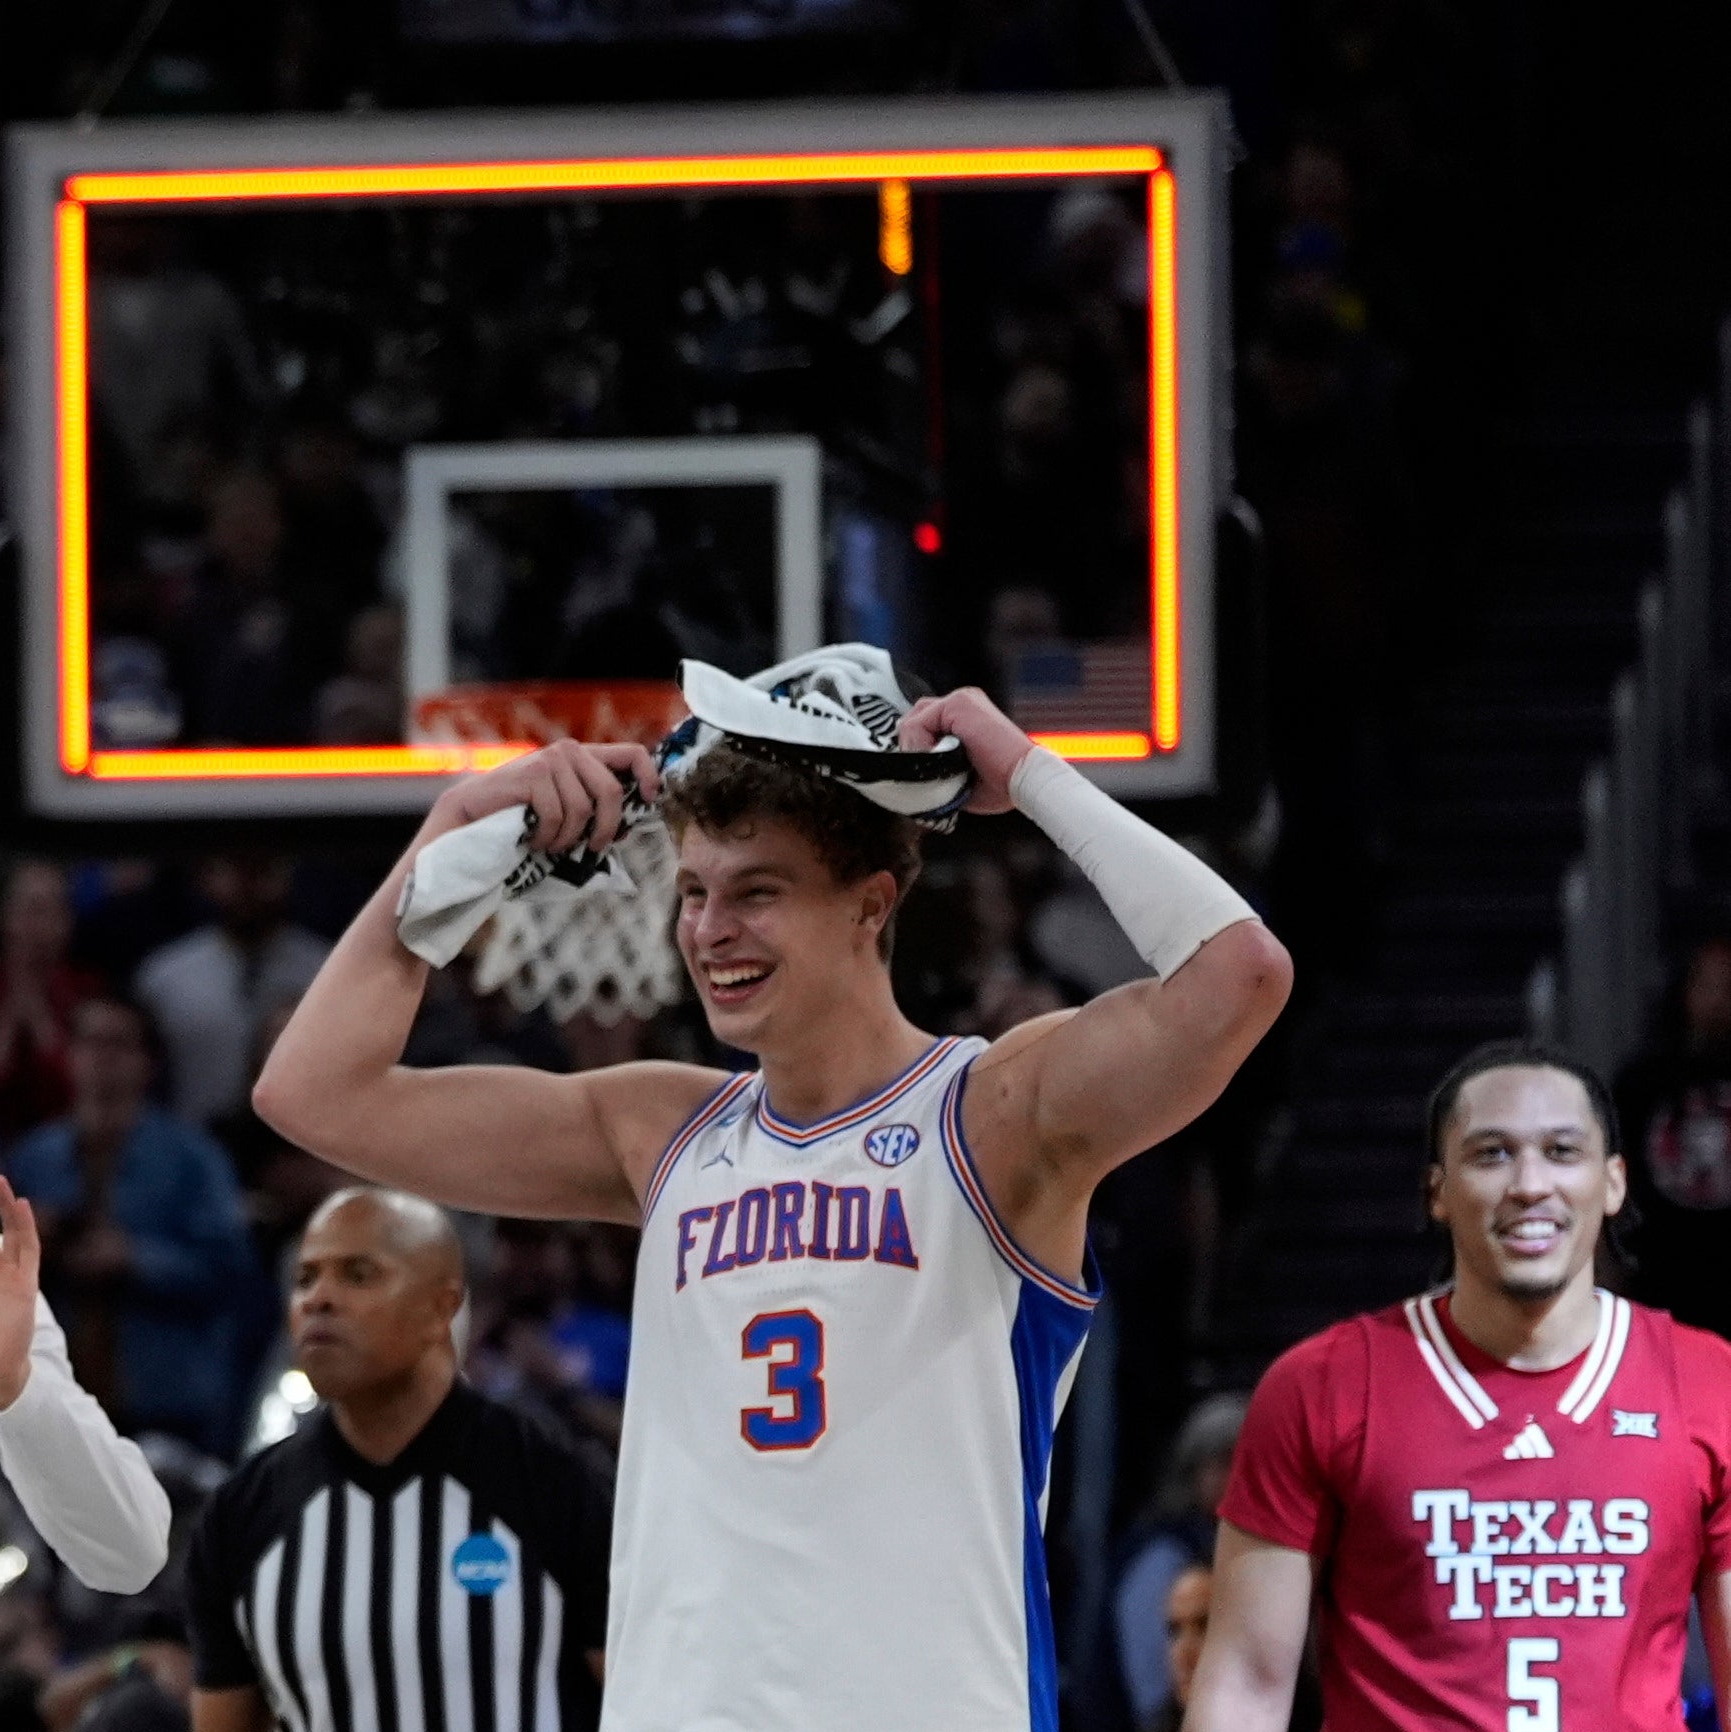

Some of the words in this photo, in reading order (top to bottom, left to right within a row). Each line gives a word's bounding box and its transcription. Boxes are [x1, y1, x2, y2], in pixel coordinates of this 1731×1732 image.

[865, 1125, 919, 1166] SEC
[675, 1180, 919, 1293] FLORIDA
[741, 1308, 827, 1452] 3
[1411, 1489, 1651, 1557] TEXAS
[1435, 1553, 1627, 1620] TECH
